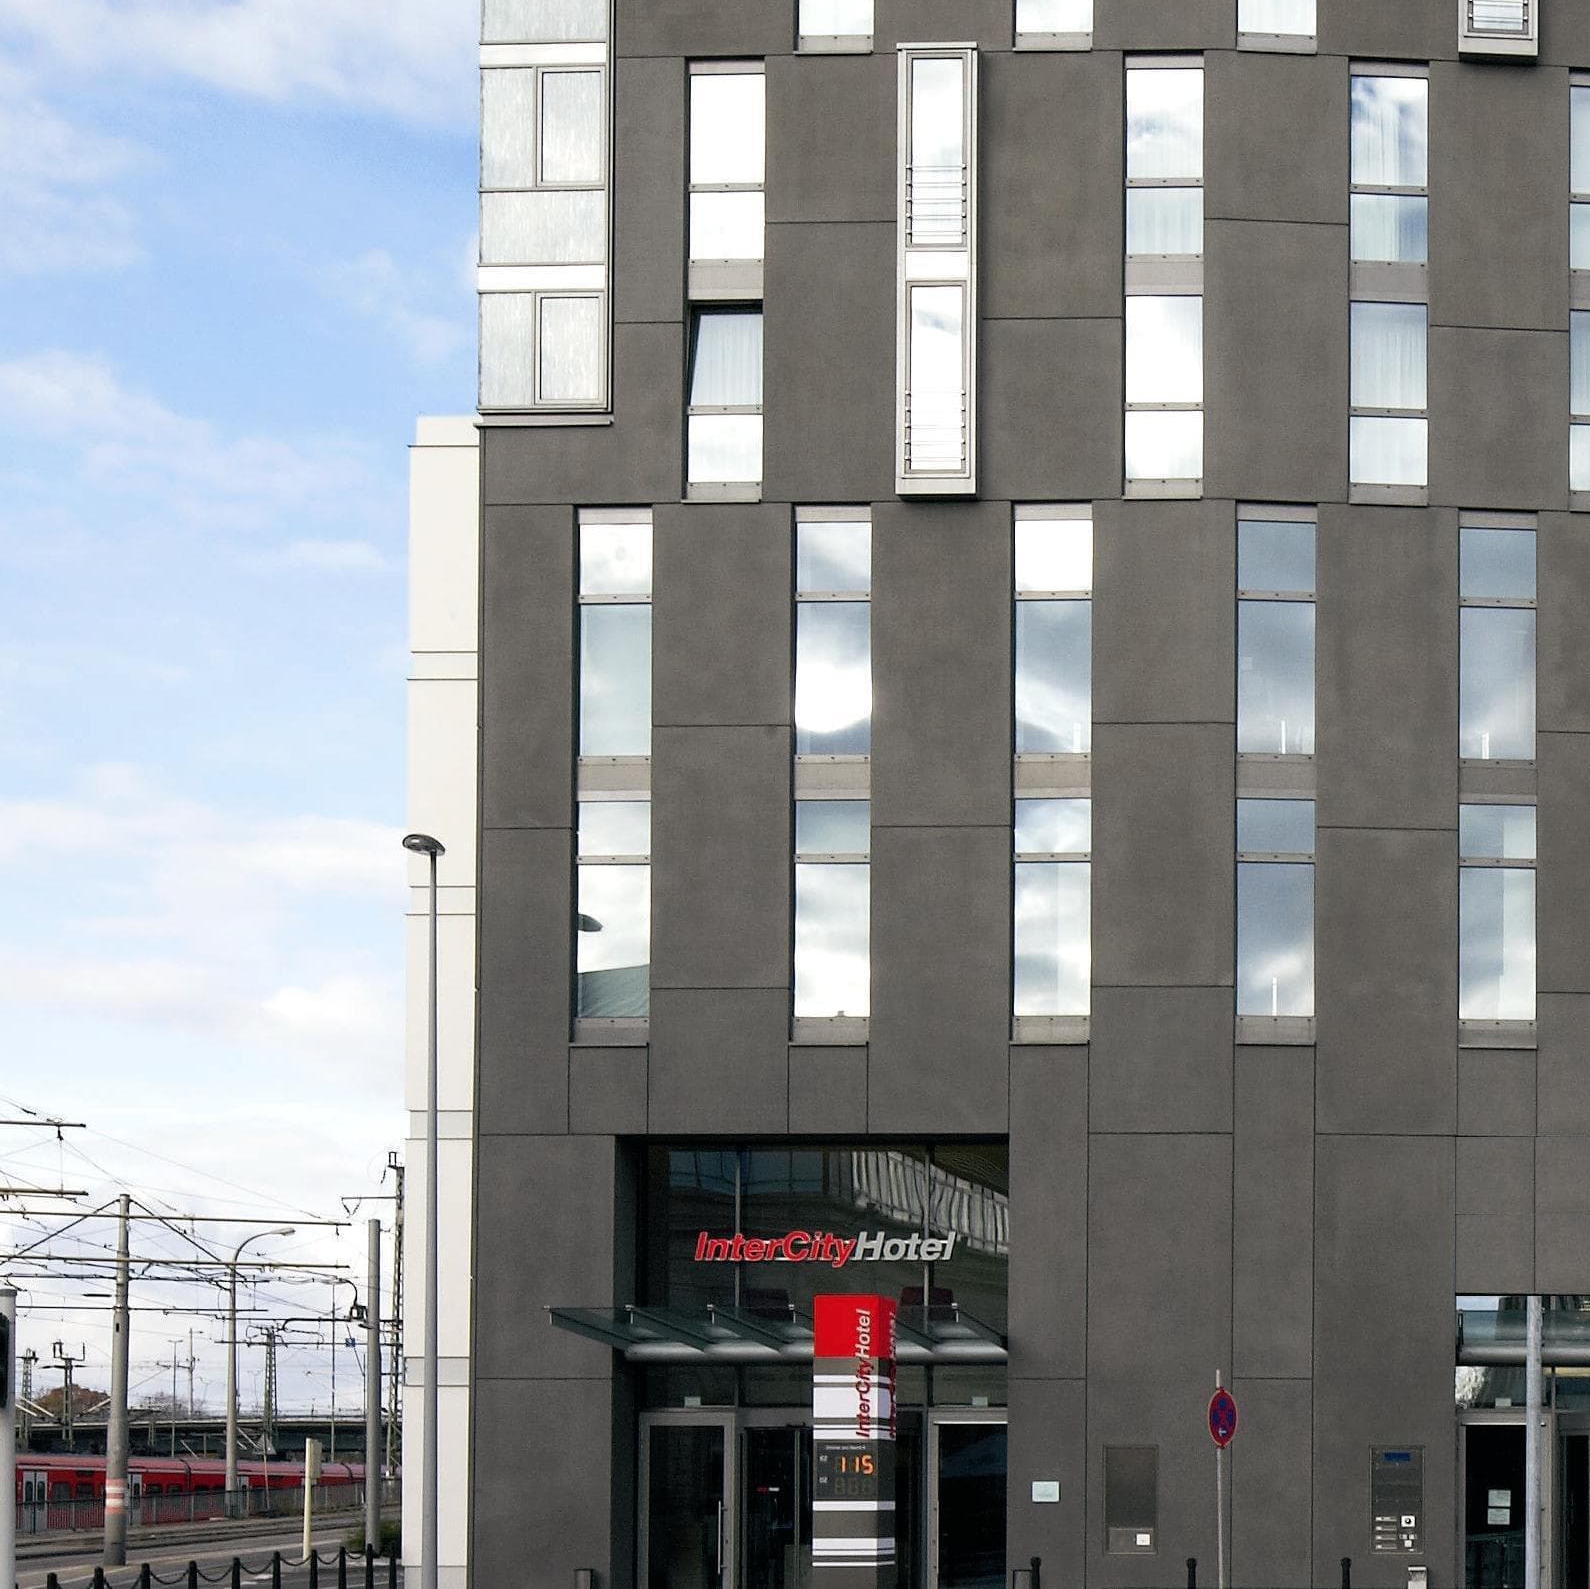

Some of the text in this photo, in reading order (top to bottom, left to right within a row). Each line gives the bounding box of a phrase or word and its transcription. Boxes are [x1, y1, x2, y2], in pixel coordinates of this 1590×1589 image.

[695, 1230, 956, 1268] InterCityHotel
[855, 1308, 874, 1439] InterCityHotel
[841, 1454, 874, 1476] 115
